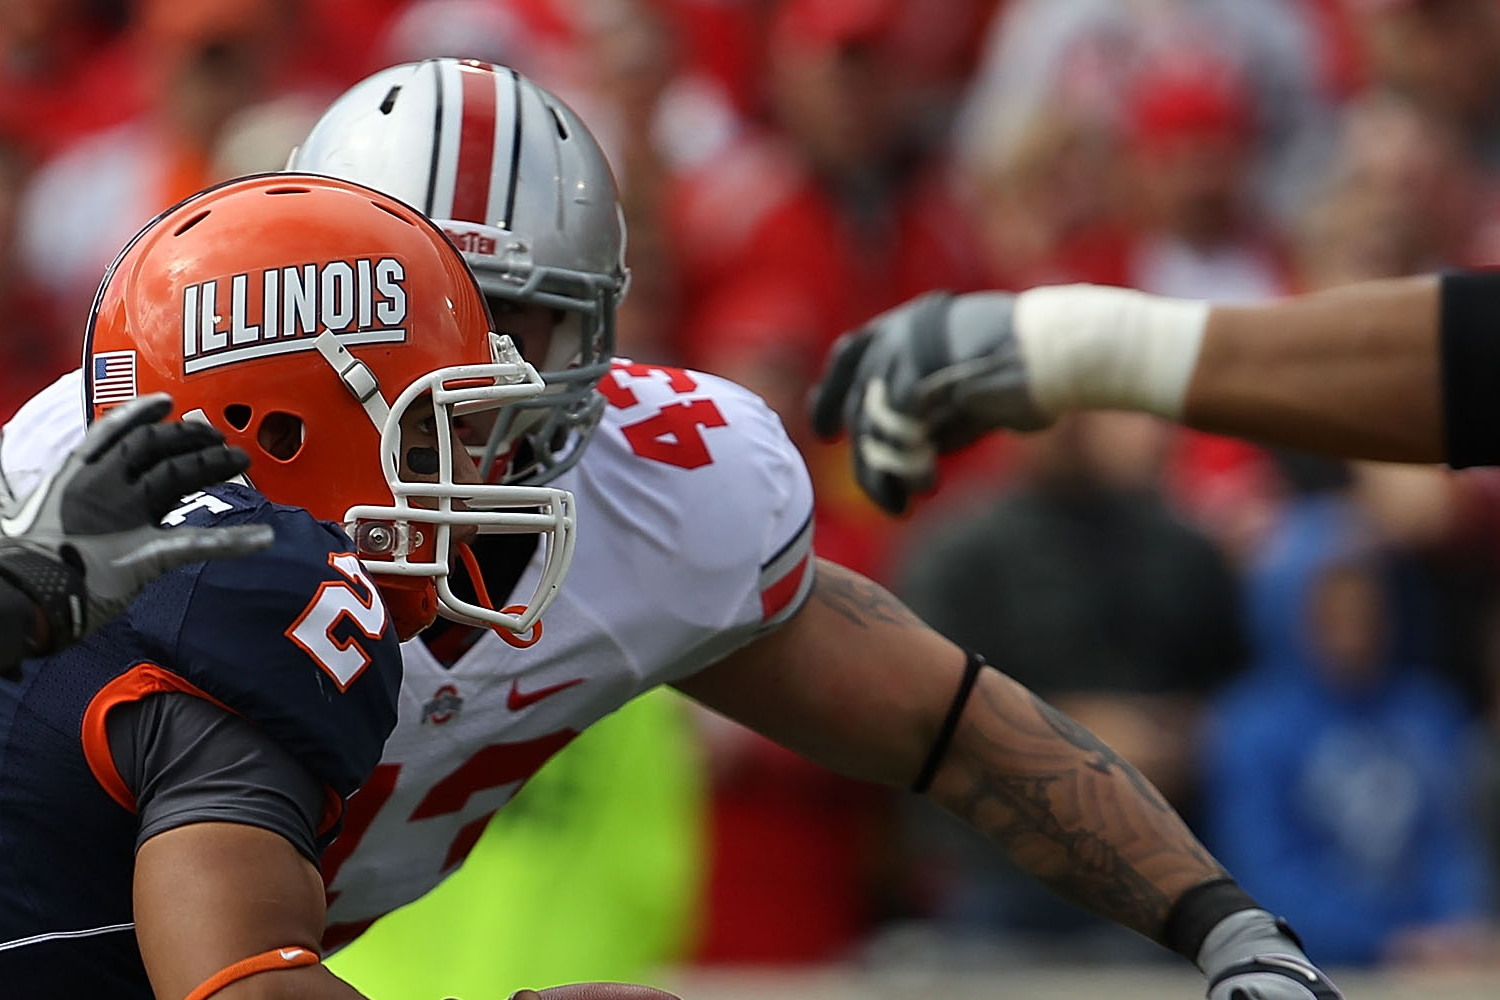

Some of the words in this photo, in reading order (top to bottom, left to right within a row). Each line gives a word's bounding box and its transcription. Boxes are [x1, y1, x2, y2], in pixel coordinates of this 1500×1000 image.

[182, 257, 407, 358] ILLINOIS
[596, 363, 728, 470] 43
[284, 552, 389, 693] 2
